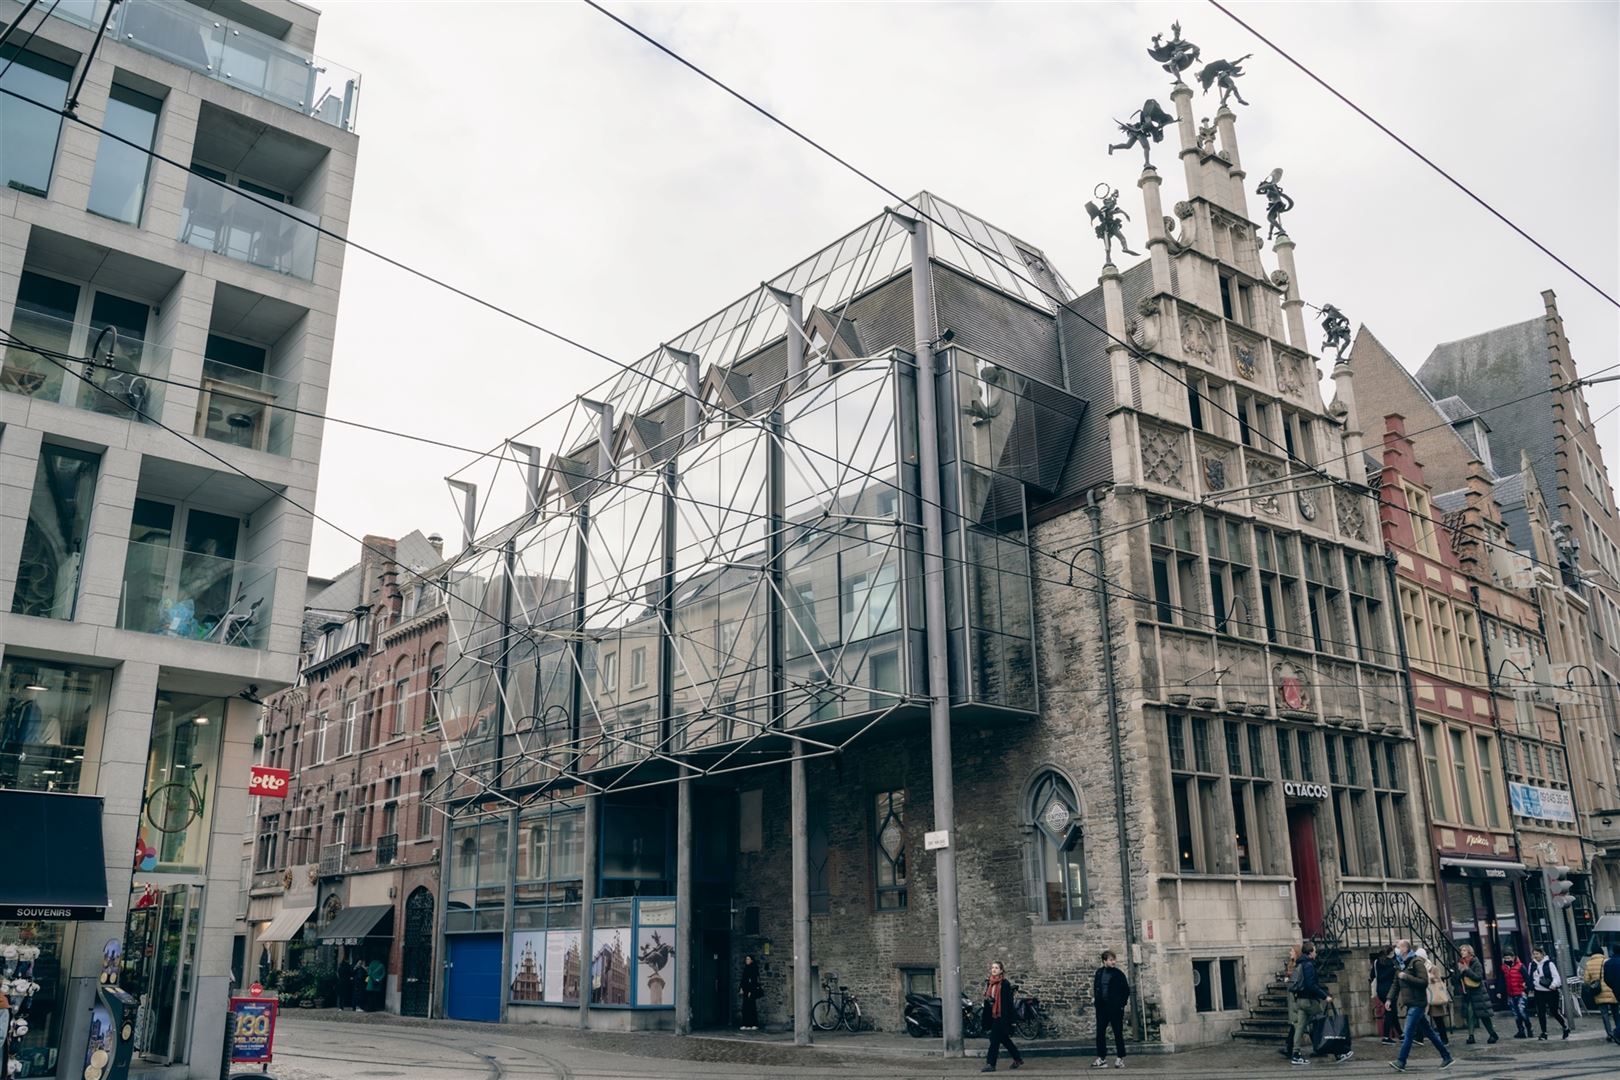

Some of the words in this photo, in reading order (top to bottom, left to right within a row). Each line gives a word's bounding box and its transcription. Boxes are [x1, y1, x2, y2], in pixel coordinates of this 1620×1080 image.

[250, 771, 286, 790] Lotto
[1284, 782, 1328, 799] O'TACOS
[16, 908, 72, 917] SOUVENIRS
[235, 1014, 270, 1036] 130
